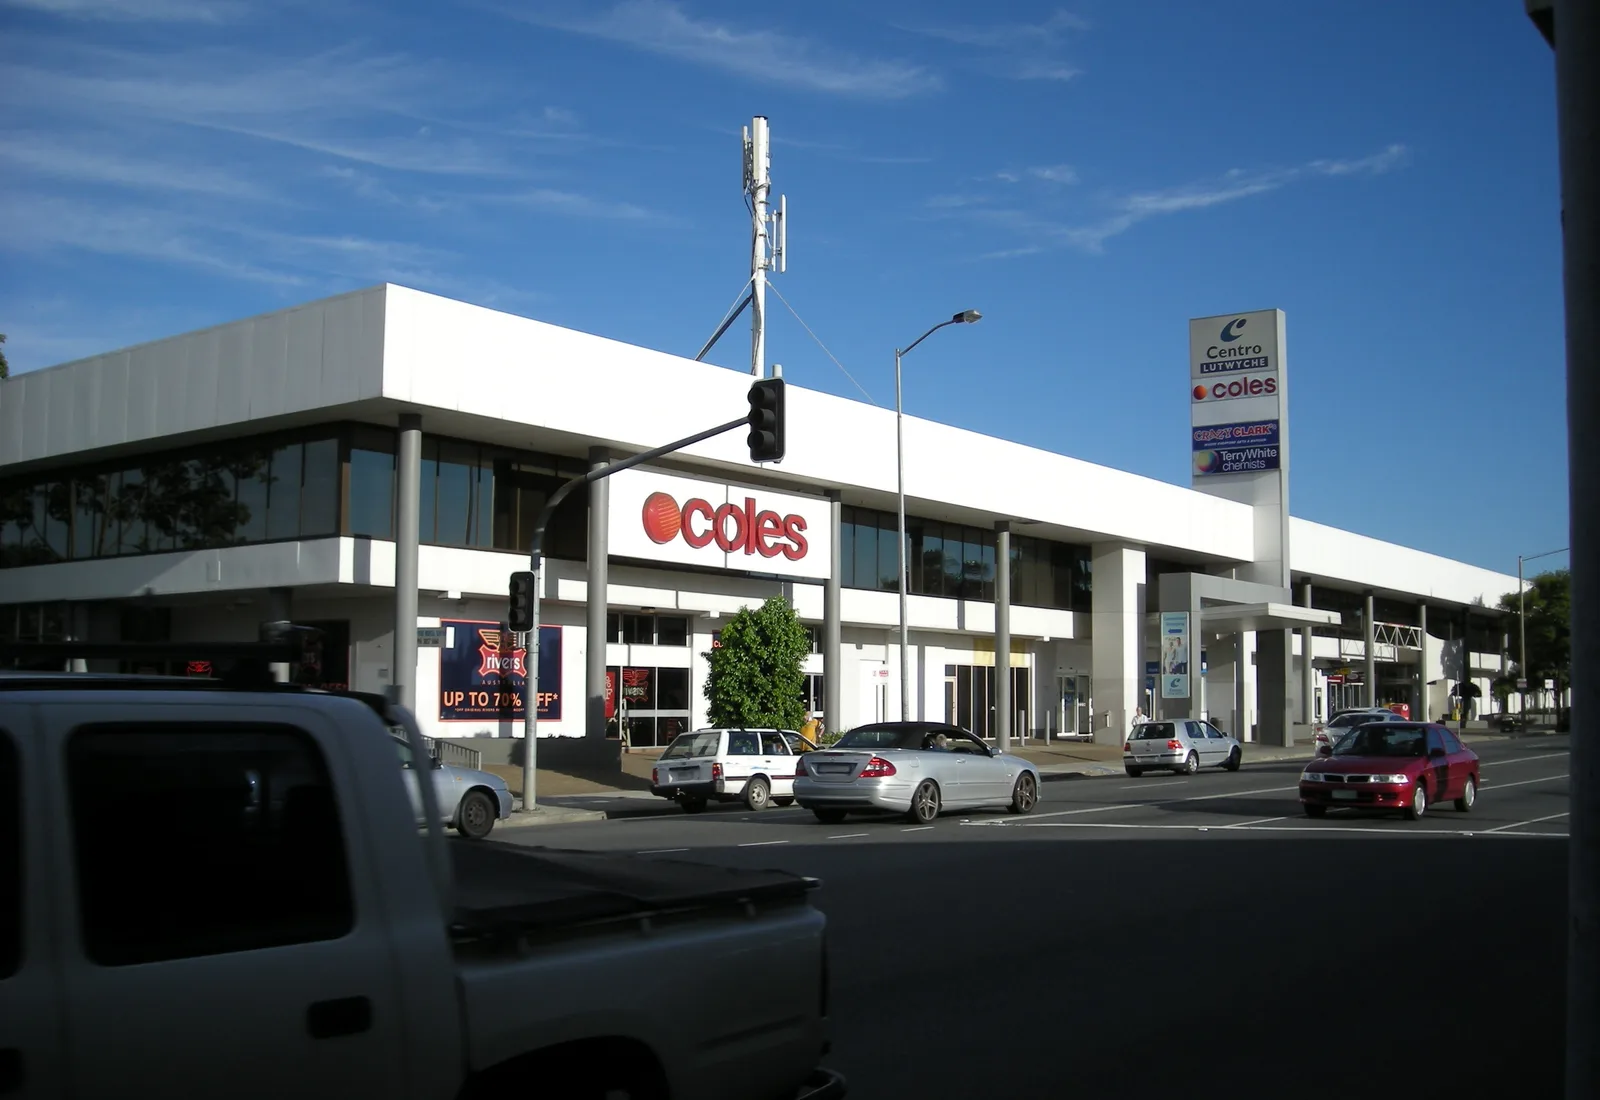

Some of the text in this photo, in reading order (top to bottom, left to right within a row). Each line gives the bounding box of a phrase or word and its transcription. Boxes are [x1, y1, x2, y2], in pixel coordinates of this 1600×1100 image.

[1206, 344, 1262, 359] Centro
[1203, 357, 1266, 372] LUTWYCHE
[1212, 377, 1276, 398] coles
[1194, 427, 1232, 441] CRAZY
[1220, 448, 1277, 462] TerryWhite
[1222, 459, 1266, 471] chemists
[681, 497, 808, 561] coles
[487, 655, 520, 670] rivers
[443, 691, 558, 707] UP TO 70% FF
